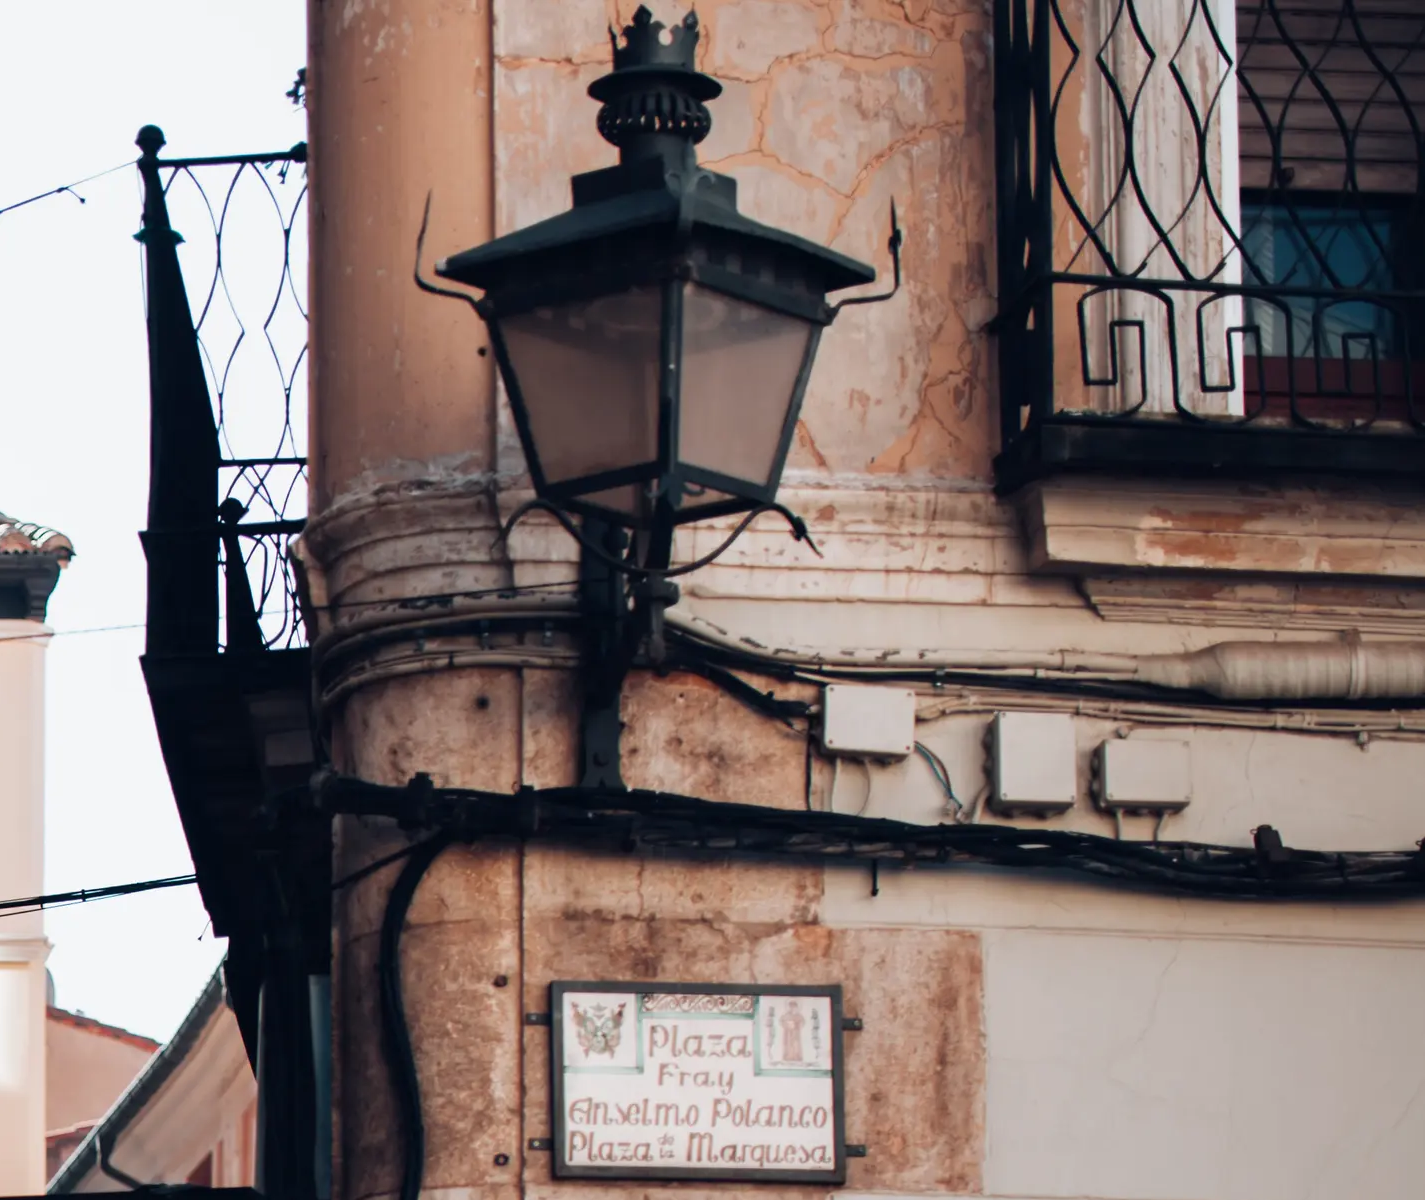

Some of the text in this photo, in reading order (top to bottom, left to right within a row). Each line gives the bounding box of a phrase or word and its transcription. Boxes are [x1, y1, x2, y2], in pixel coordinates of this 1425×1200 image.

[648, 1024, 753, 1060] Plaza
[657, 1062, 735, 1096] Fray
[568, 1096, 828, 1129] Anselmo Polanco
[568, 1130, 654, 1163] Plaza
[686, 1132, 832, 1168] Marquesa
